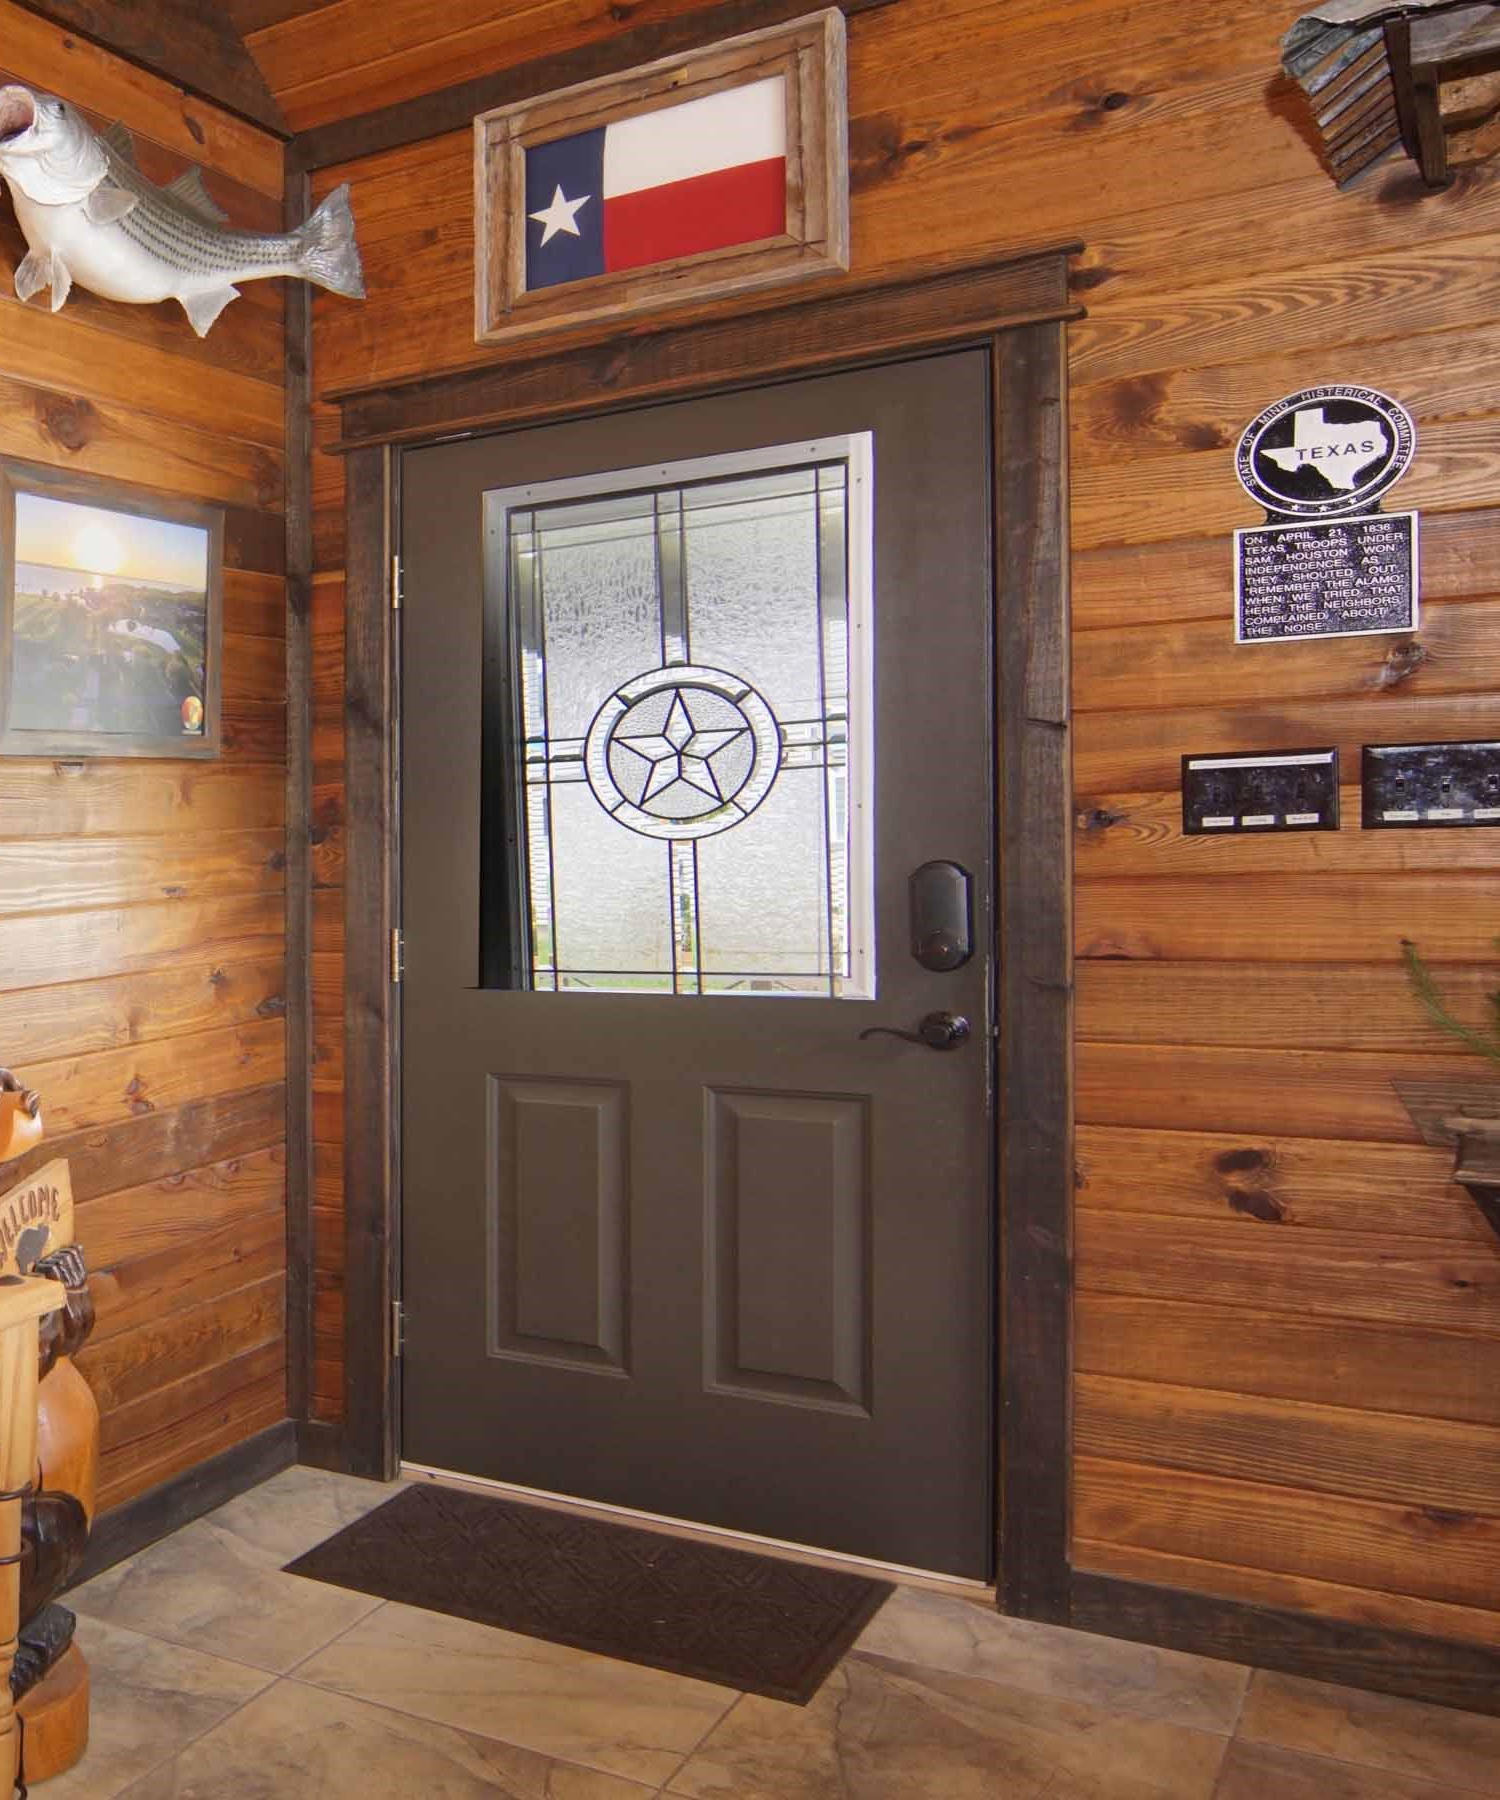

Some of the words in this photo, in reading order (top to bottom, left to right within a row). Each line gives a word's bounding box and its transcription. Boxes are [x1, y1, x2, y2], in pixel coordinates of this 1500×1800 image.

[1301, 387, 1383, 406] HISTERICAL
[1258, 400, 1290, 425] MIND
[1243, 433, 1256, 447] OF
[1387, 407, 1412, 470] COMMITTEE
[1296, 440, 1375, 461] TEXAS
[1238, 456, 1257, 487] STATE
[1244, 536, 1263, 545] ON
[1277, 531, 1314, 542] APRIL
[1362, 523, 1391, 533] 1836
[1245, 544, 1285, 555] TEXAS
[1296, 538, 1348, 550] TROOPS
[1357, 533, 1404, 544] UNDER
[1244, 556, 1271, 566] SAM
[1286, 548, 1348, 562] HOUSTON
[1364, 544, 1395, 554] WON
[1245, 560, 1343, 575] INDEPENDENCE
[1361, 555, 1379, 565] AS
[1245, 575, 1278, 585] THEY
[1292, 569, 1354, 581] SHOUTED
[1325, 579, 1350, 588] THE
[1245, 595, 1282, 605] WHEN
[1291, 592, 1312, 602] WE
[1322, 589, 1360, 599] TRIED
[1370, 585, 1402, 595] THAT
[1245, 605, 1280, 615] HERE
[1289, 602, 1314, 612] THE
[1323, 595, 1400, 609] NEIGHBORS
[1244, 612, 1327, 625] COMPLAINED
[1341, 608, 1385, 618] ABOUT
[1245, 626, 1270, 636] THE
[1284, 622, 1324, 633] NOISE
